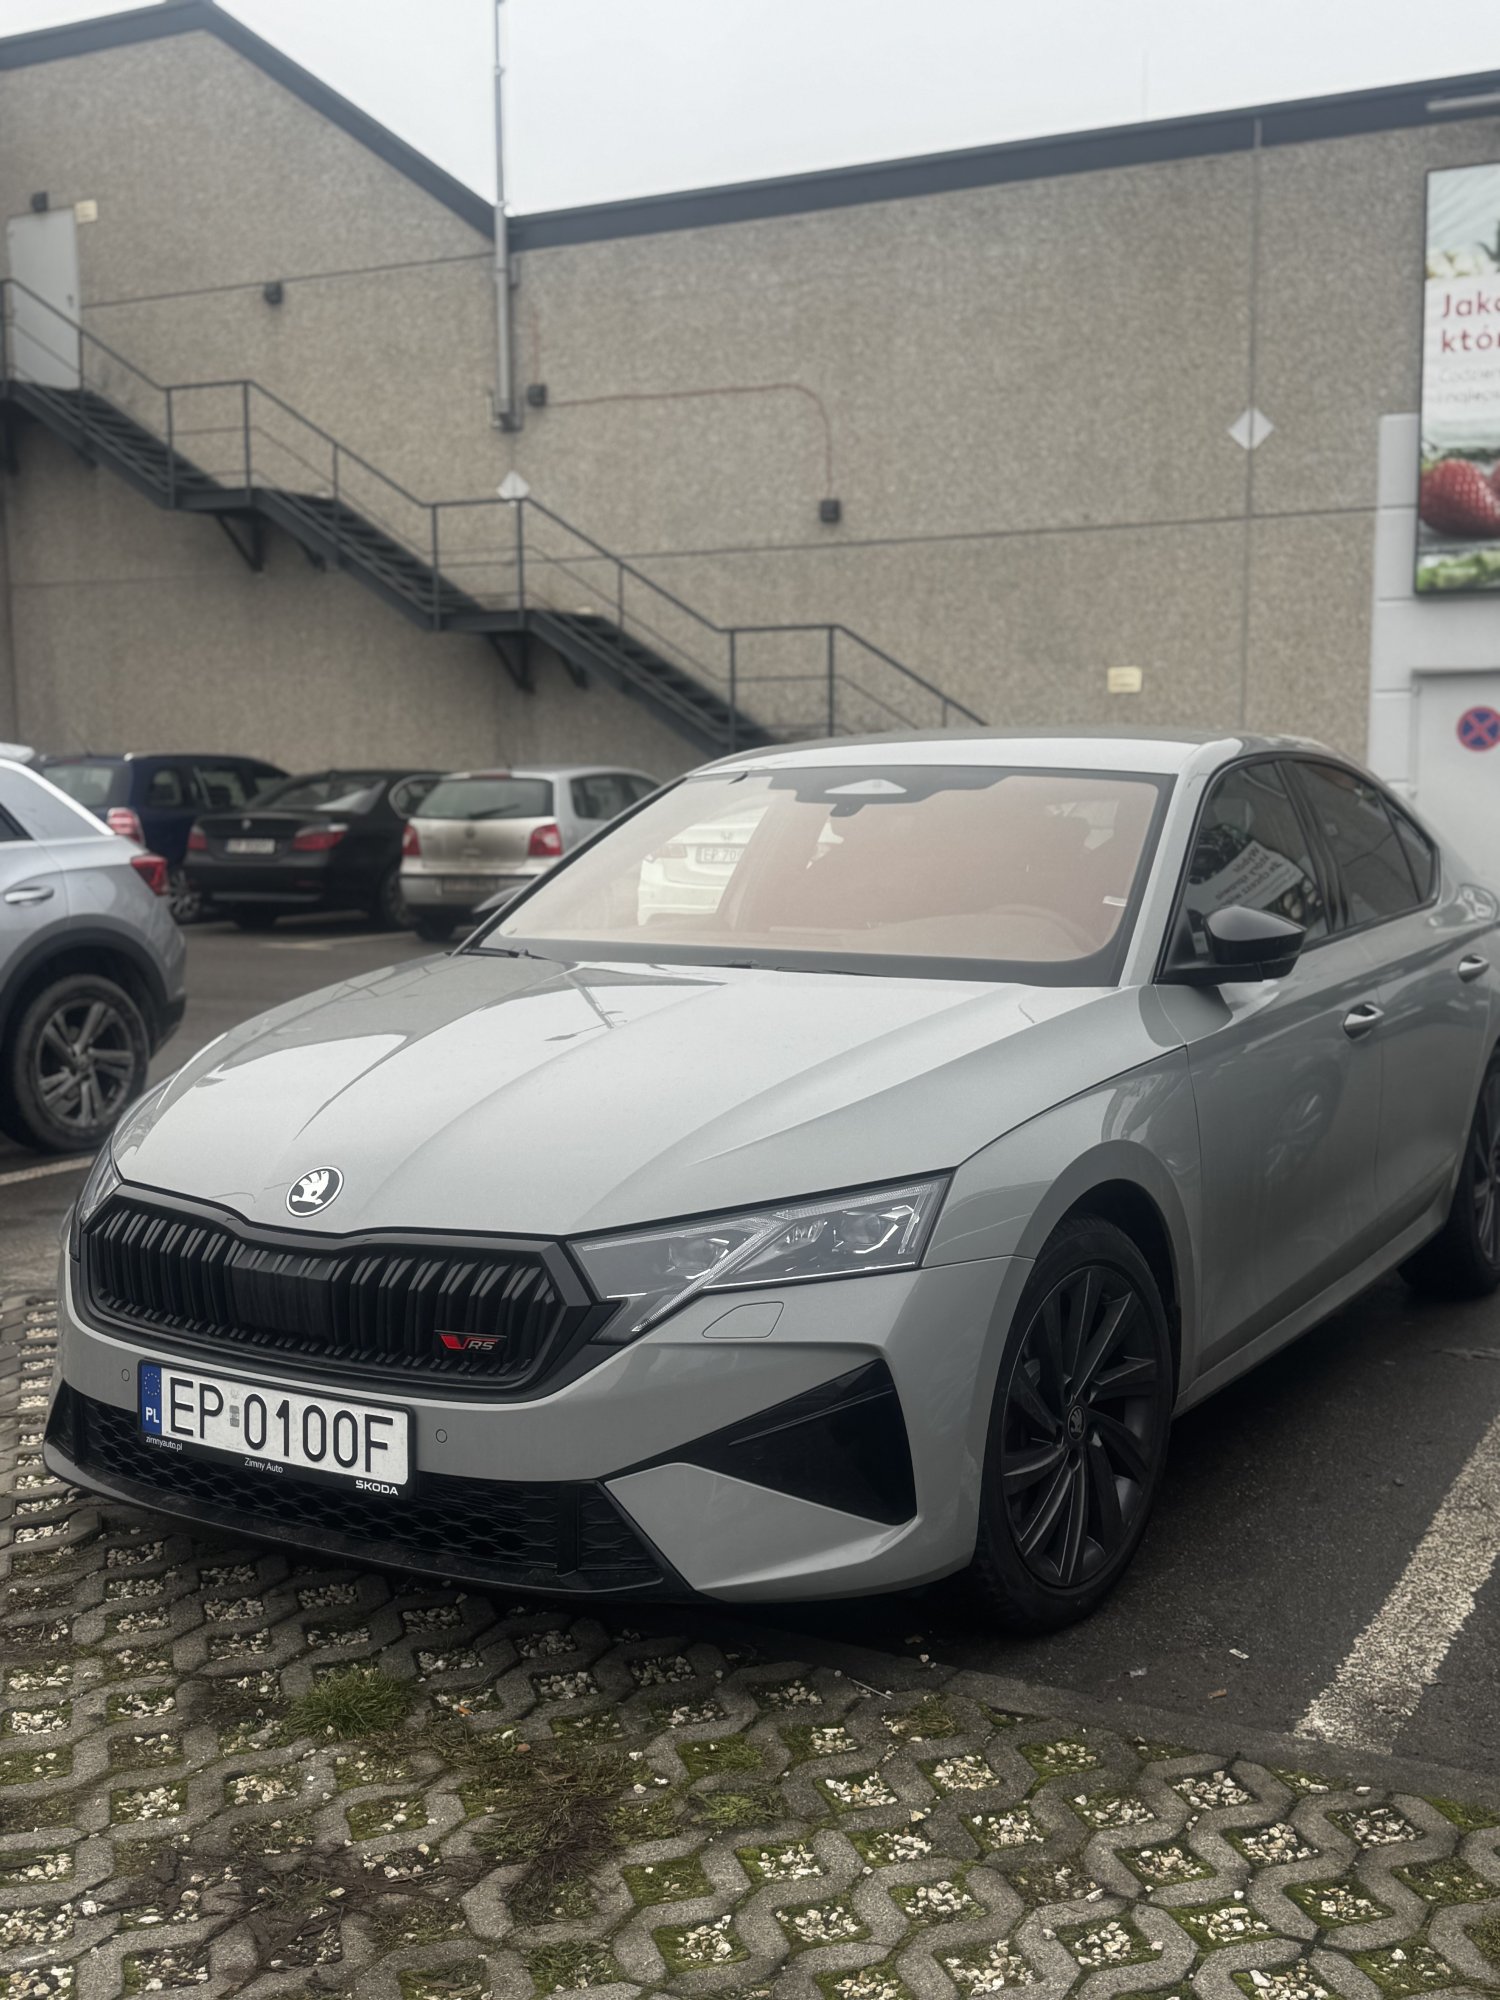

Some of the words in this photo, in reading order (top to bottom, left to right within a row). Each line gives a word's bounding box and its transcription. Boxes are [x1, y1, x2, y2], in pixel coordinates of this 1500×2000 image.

[145, 1406, 160, 1424] PL
[170, 1376, 224, 1439] EP
[244, 1393, 394, 1473] 0100F
[145, 1436, 183, 1452] zimnyauto.pl
[244, 1457, 266, 1472] Zimny
[266, 1462, 284, 1474] Auto
